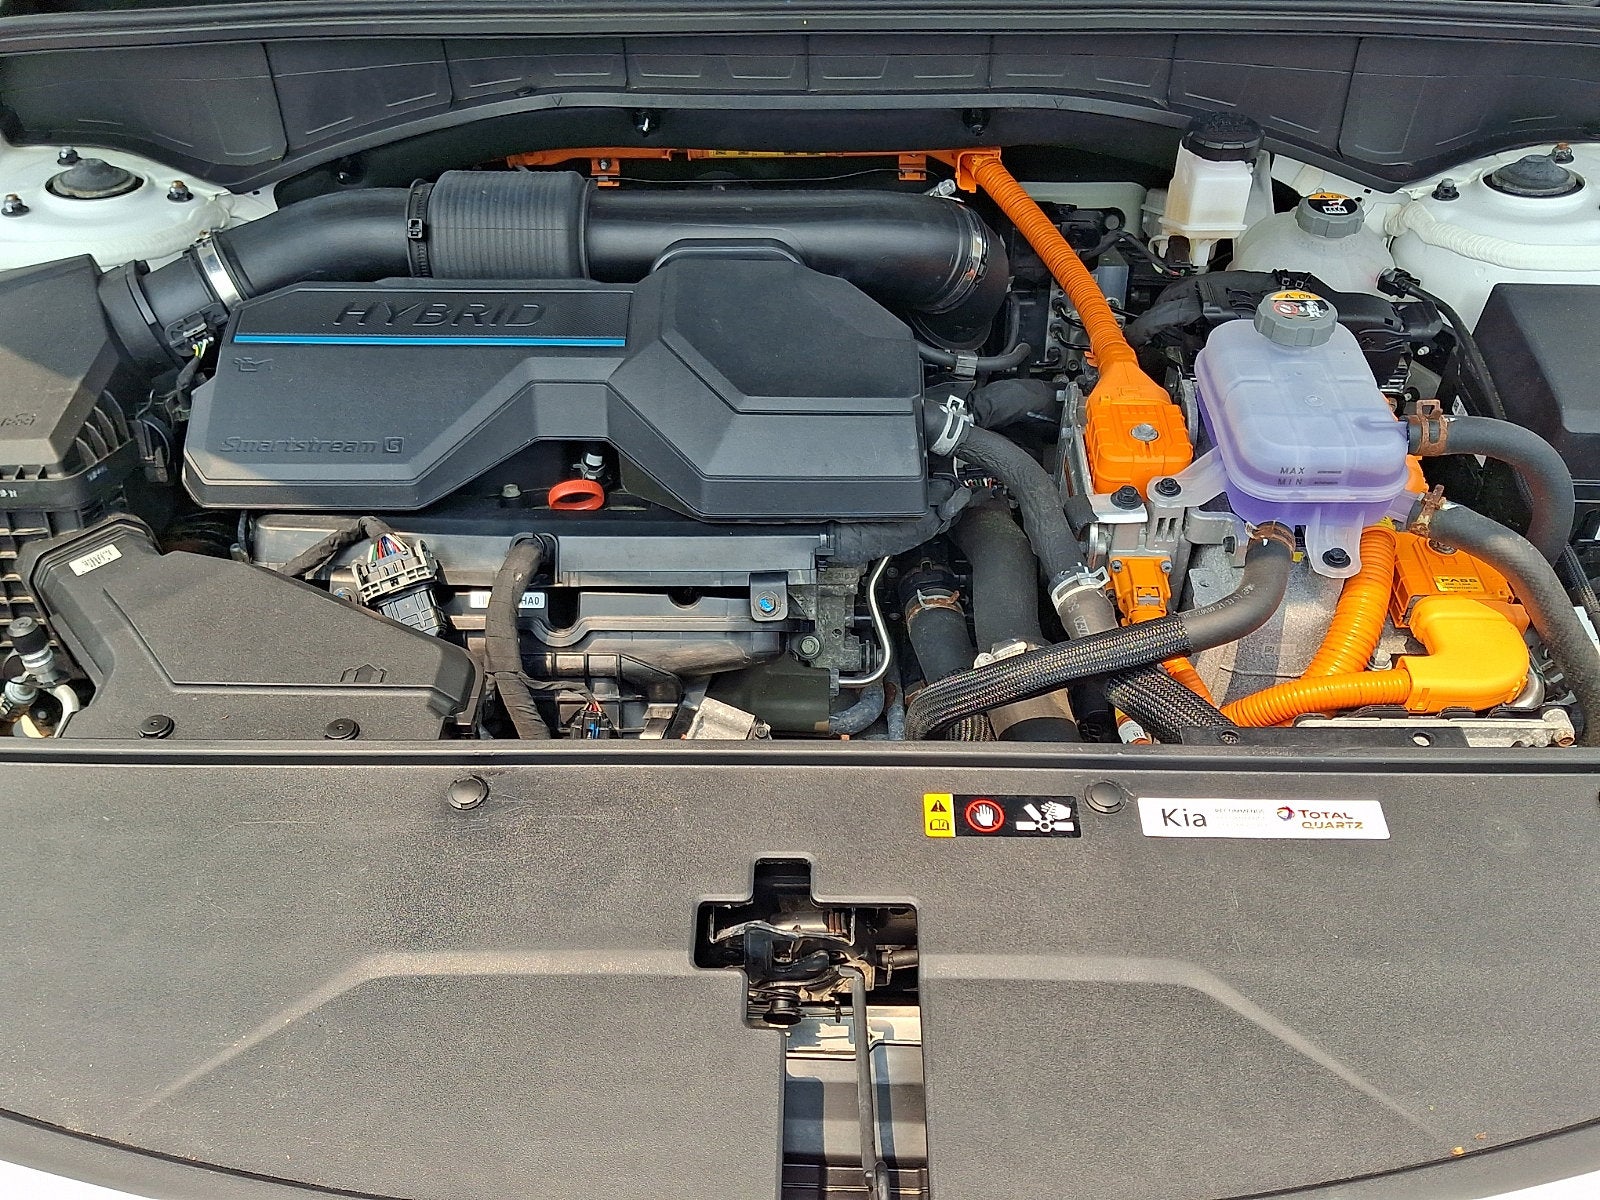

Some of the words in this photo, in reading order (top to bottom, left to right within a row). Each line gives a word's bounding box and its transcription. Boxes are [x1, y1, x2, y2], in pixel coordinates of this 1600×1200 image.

[333, 301, 546, 327] HYBRID
[220, 436, 379, 453] Smartstream
[383, 436, 404, 453] G
[1280, 467, 1305, 475] MAX
[1277, 478, 1302, 486] MIN
[1161, 808, 1207, 827] Kia
[1301, 821, 1364, 829] QUARTZ
